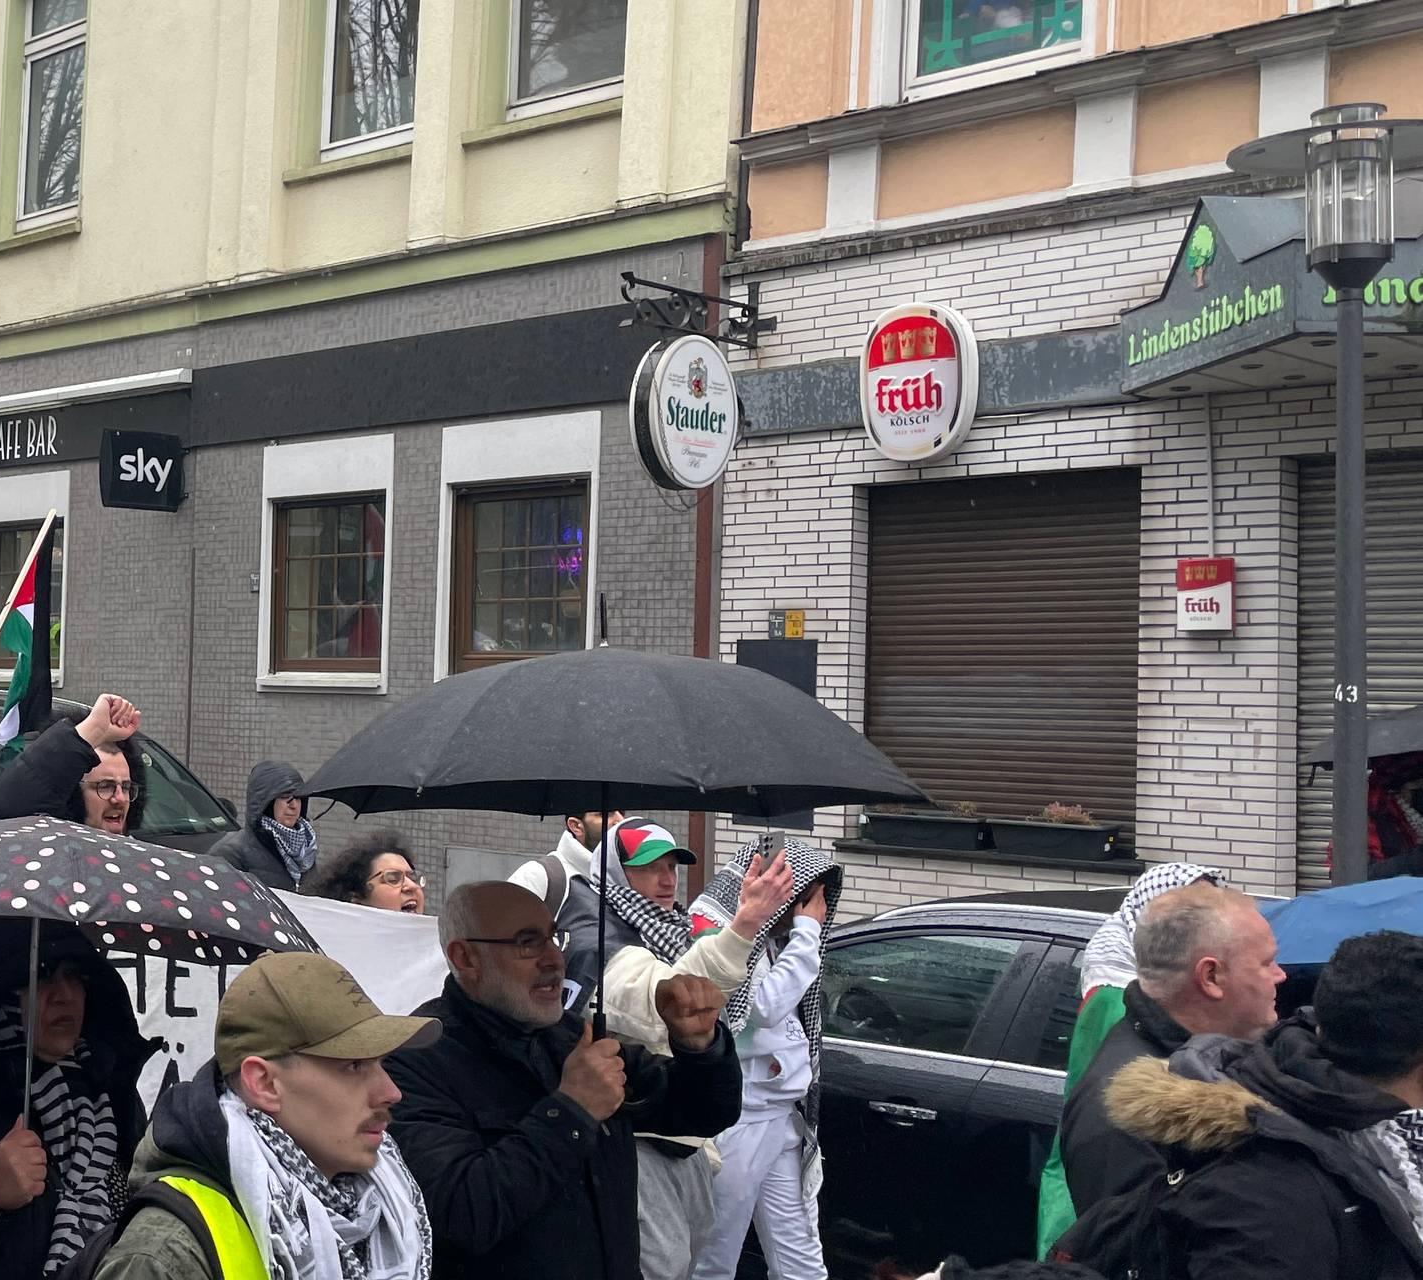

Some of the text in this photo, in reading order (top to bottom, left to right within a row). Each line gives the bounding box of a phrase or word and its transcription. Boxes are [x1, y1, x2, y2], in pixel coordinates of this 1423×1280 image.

[1128, 284, 1284, 367] Lindenstübchen
[875, 371, 943, 414] früh
[666, 396, 727, 434] Stauder
[889, 414, 930, 427] KÖLSCH
[26, 415, 58, 459] BAR
[119, 447, 174, 493] sky
[1184, 596, 1221, 615] früh
